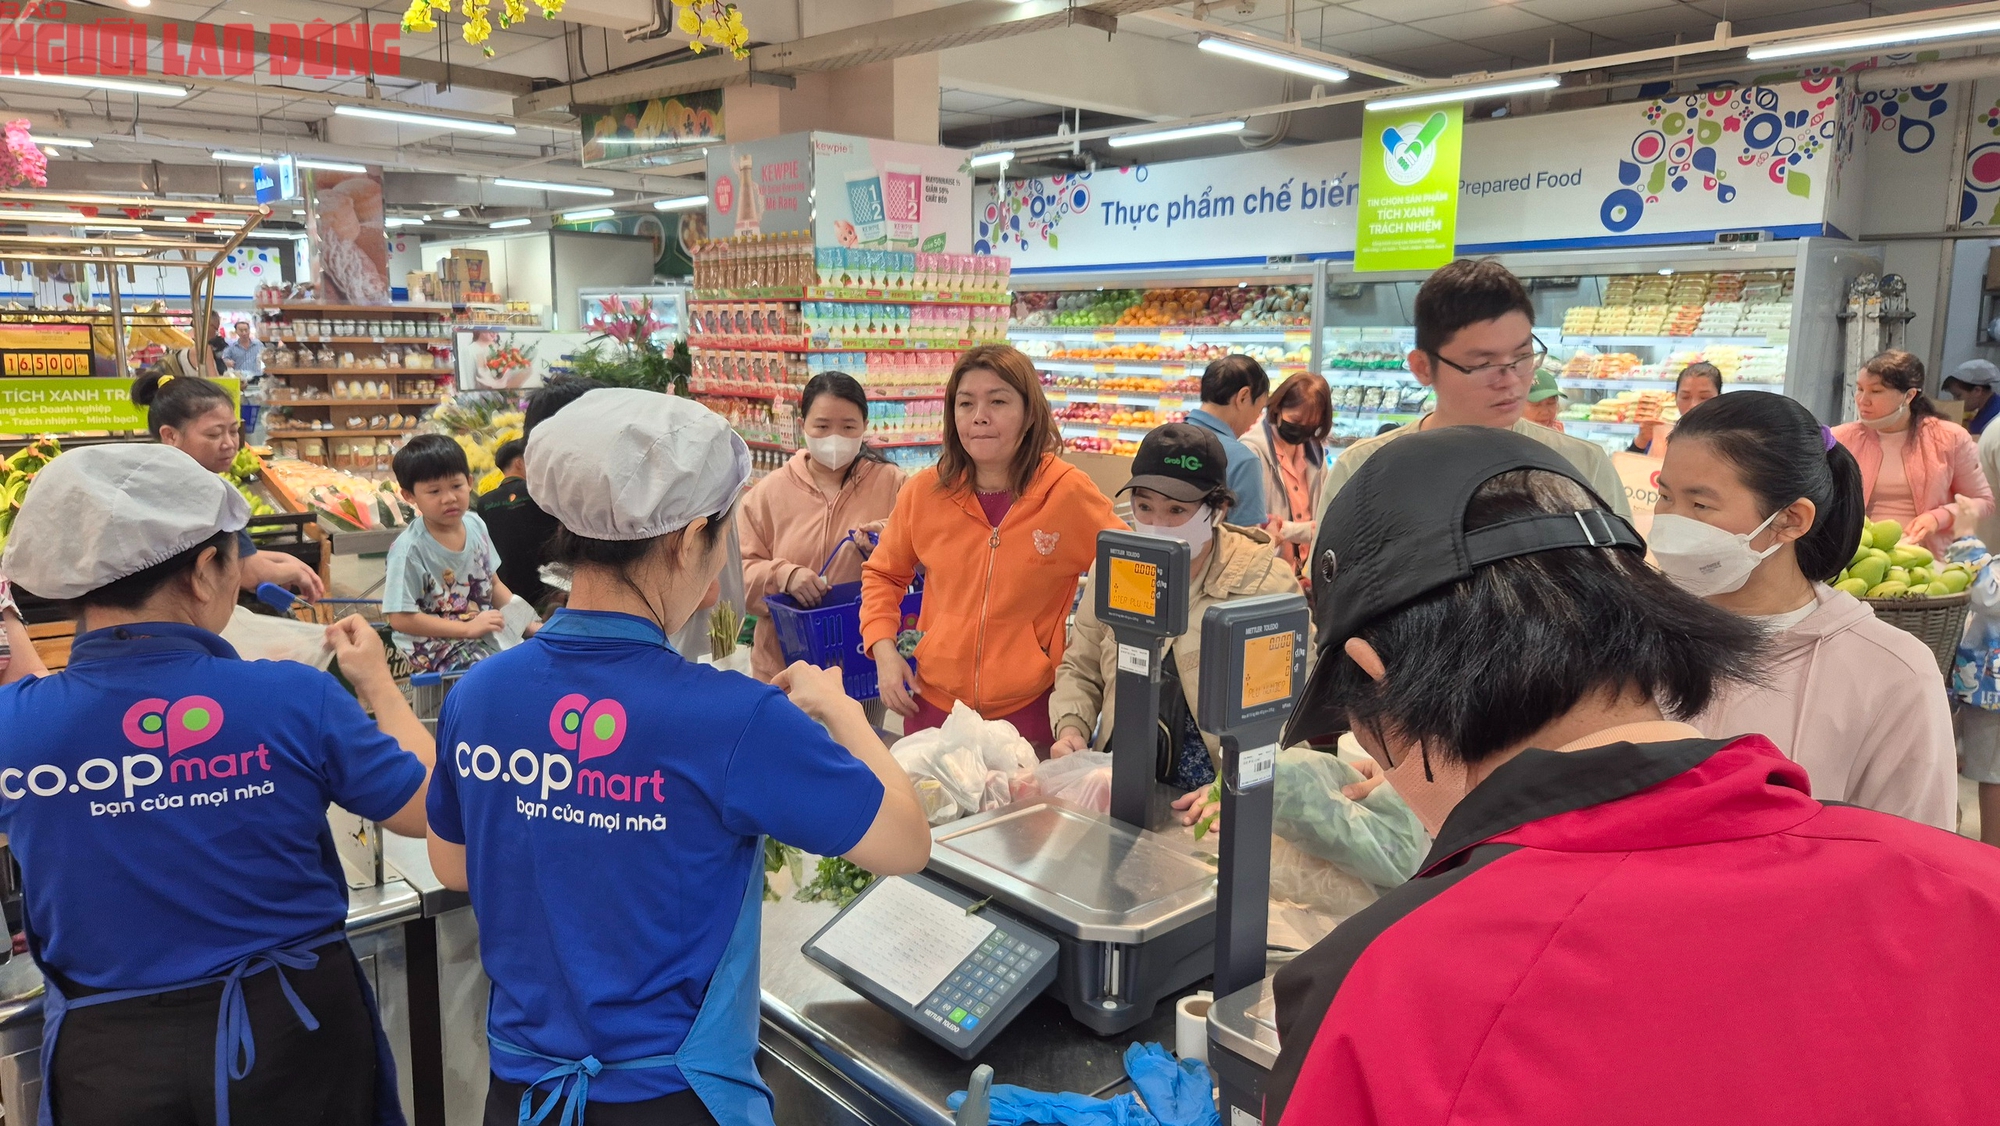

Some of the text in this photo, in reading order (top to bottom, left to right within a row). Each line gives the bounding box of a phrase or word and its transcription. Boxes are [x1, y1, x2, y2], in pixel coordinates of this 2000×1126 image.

[815, 140, 848, 155] kewpie
[762, 160, 799, 182] KEWPIE
[1536, 168, 1583, 189] Food
[1101, 171, 1359, 230] Thực phẩm chế biến
[1377, 206, 1435, 220] TÍCH XANH
[1369, 219, 1443, 234] TRÁCH NHIỆM
[8, 357, 73, 372] 16.500
[2, 388, 45, 402] TÍCH
[49, 389, 99, 402] XANH
[18, 406, 38, 414] các
[40, 405, 74, 414] Doanh
[76, 404, 112, 415] nghiệp
[12, 415, 138, 426] Trách nhiệm Minh bạch
[1163, 456, 1180, 465] Grab
[1624, 486, 1660, 506] o.op
[1109, 547, 1141, 558] METTLER TOLEDO
[1134, 563, 1156, 577] 0.000
[1245, 622, 1279, 635] METTLER TOLEDO
[1268, 633, 1292, 651] 0.000
[1296, 632, 1302, 642] kg
[0, 743, 272, 799] co.op mart
[455, 741, 665, 803] co.op mart
[90, 799, 135, 818] bạn
[140, 793, 184, 812] của
[190, 787, 229, 808] mọi
[516, 795, 547, 821] bạn
[552, 803, 585, 825] của
[588, 812, 621, 834] mọi
[923, 1008, 960, 1034] METTLER TOLEDO
